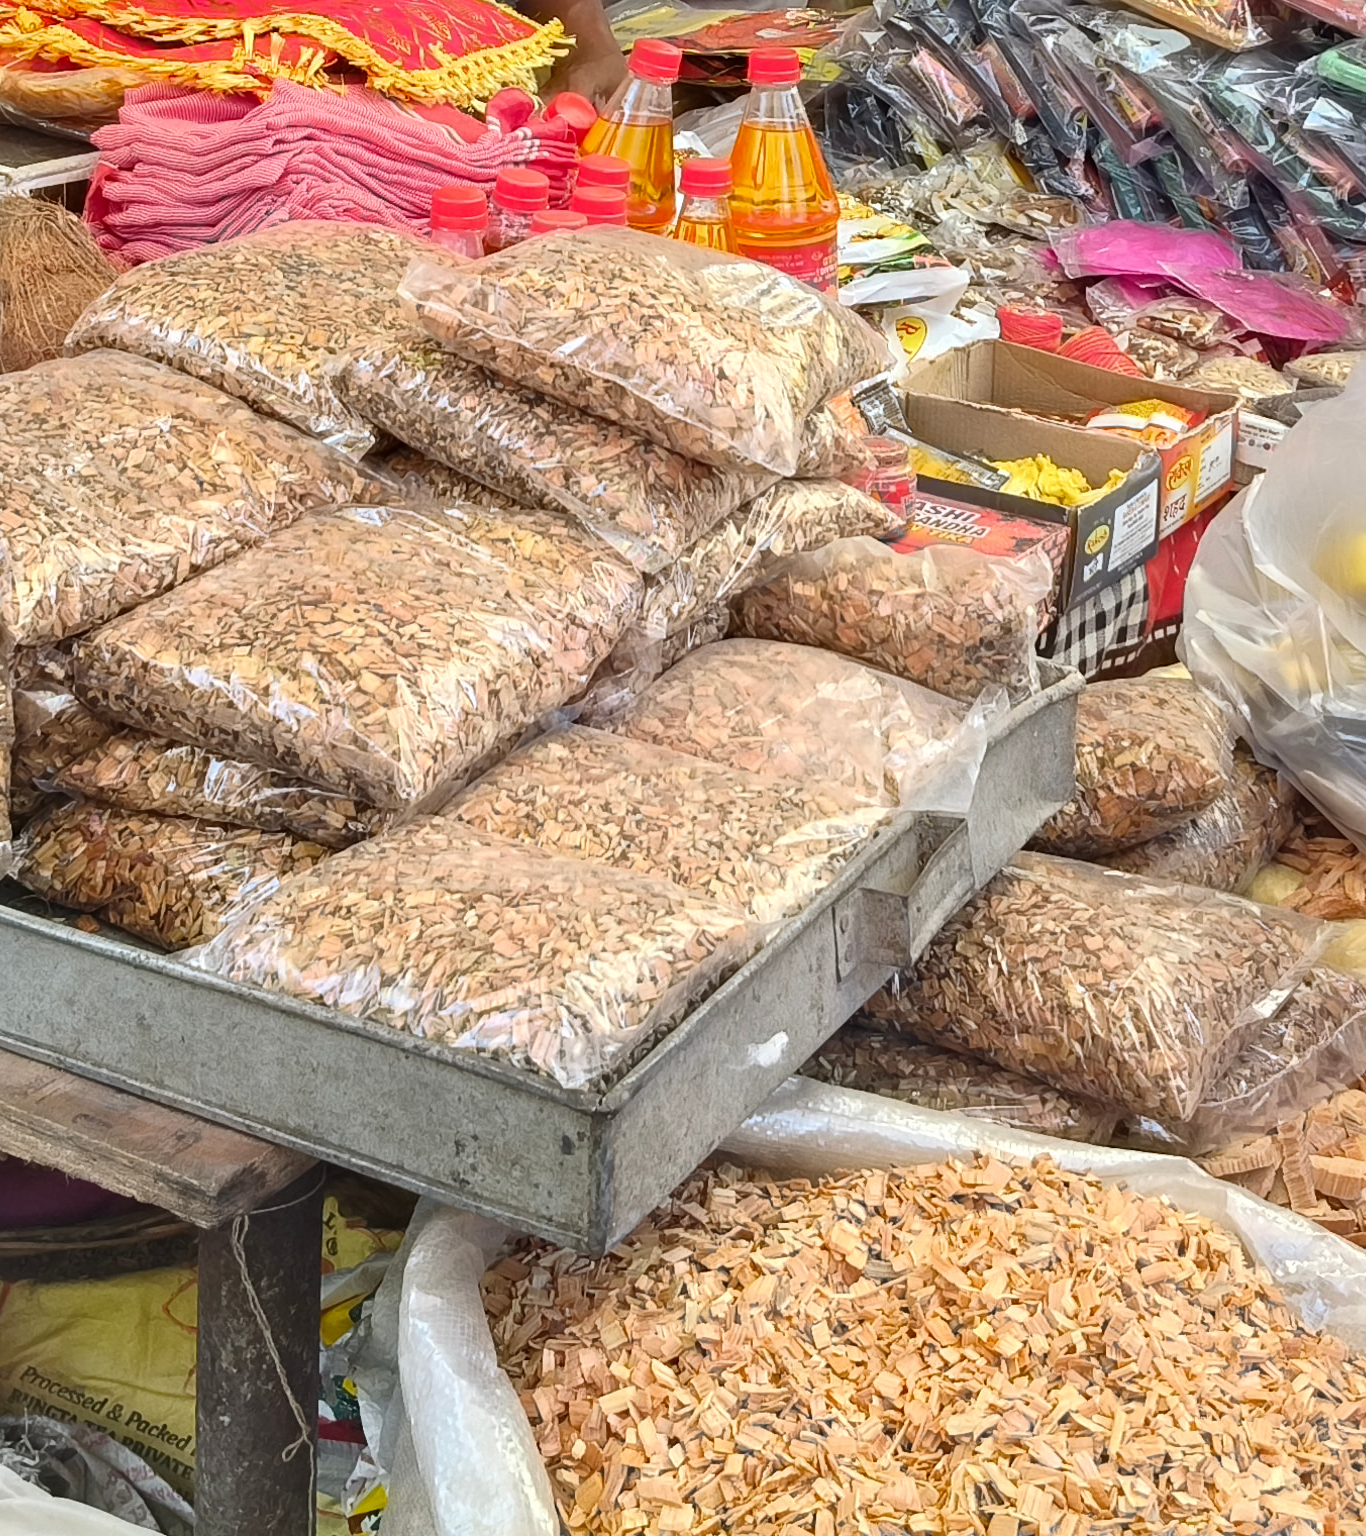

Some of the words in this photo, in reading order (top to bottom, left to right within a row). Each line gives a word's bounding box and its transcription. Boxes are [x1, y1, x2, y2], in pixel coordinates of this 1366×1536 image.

[19, 1365, 109, 1415] Processed
[106, 1403, 125, 1423] &
[124, 1410, 193, 1451] Packed
[120, 1434, 196, 1481] PRIVATE
